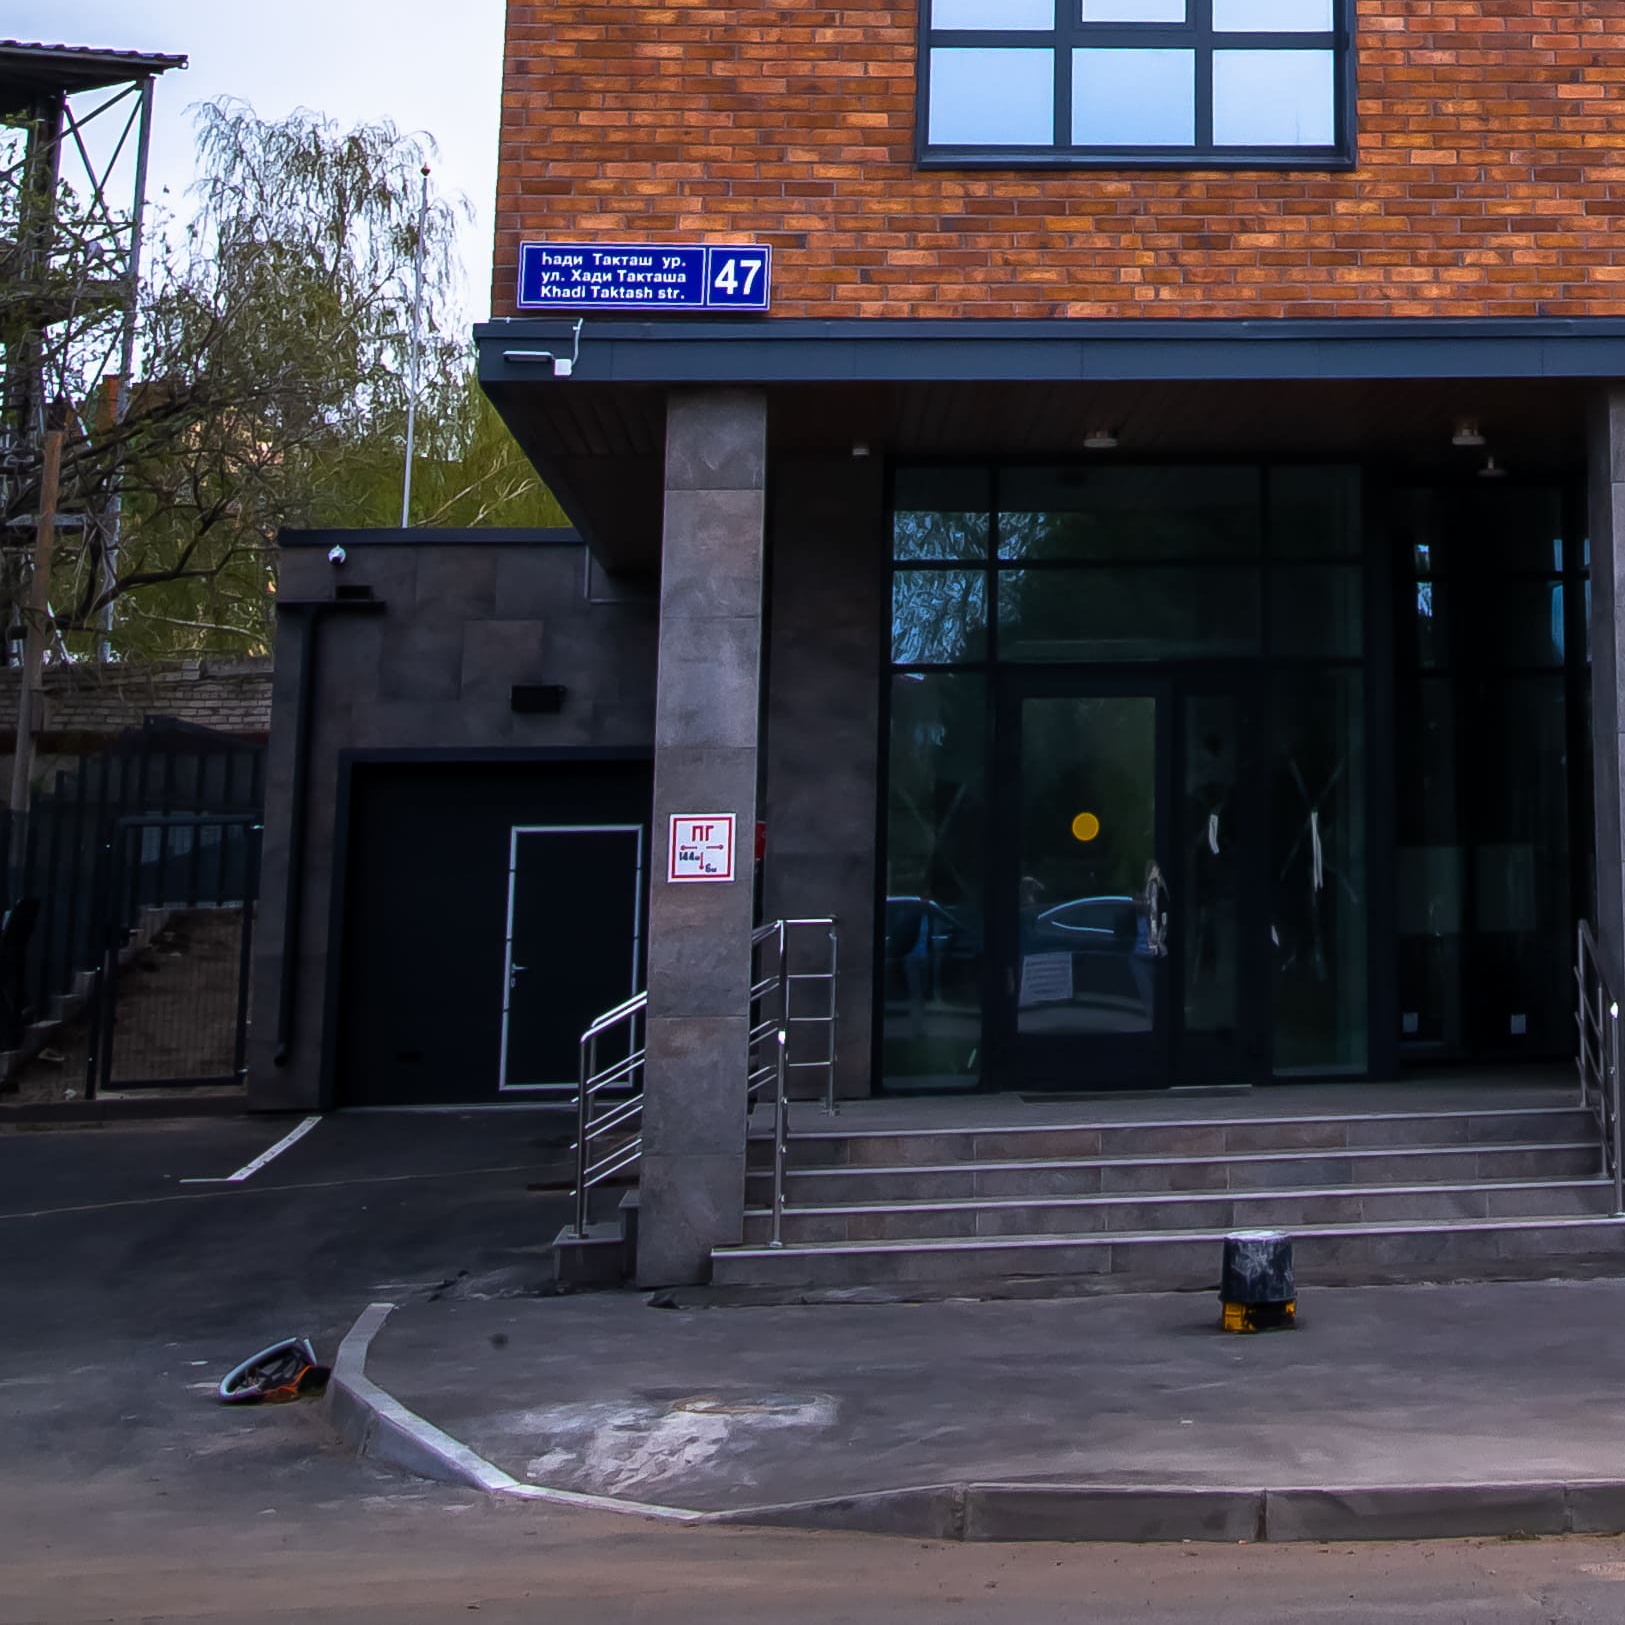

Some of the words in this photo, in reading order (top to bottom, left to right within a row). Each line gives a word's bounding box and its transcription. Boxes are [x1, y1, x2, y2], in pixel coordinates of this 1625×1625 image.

[592, 253, 652, 266] Такташ
[662, 257, 686, 269] ур.
[541, 271, 565, 284] ул.
[570, 269, 612, 283] Хади
[617, 269, 686, 283] Такташа
[715, 259, 762, 295] 47
[541, 286, 585, 298] Khadi
[590, 286, 653, 299] Taktash
[658, 287, 685, 299] str.
[692, 825, 714, 842] ПГ
